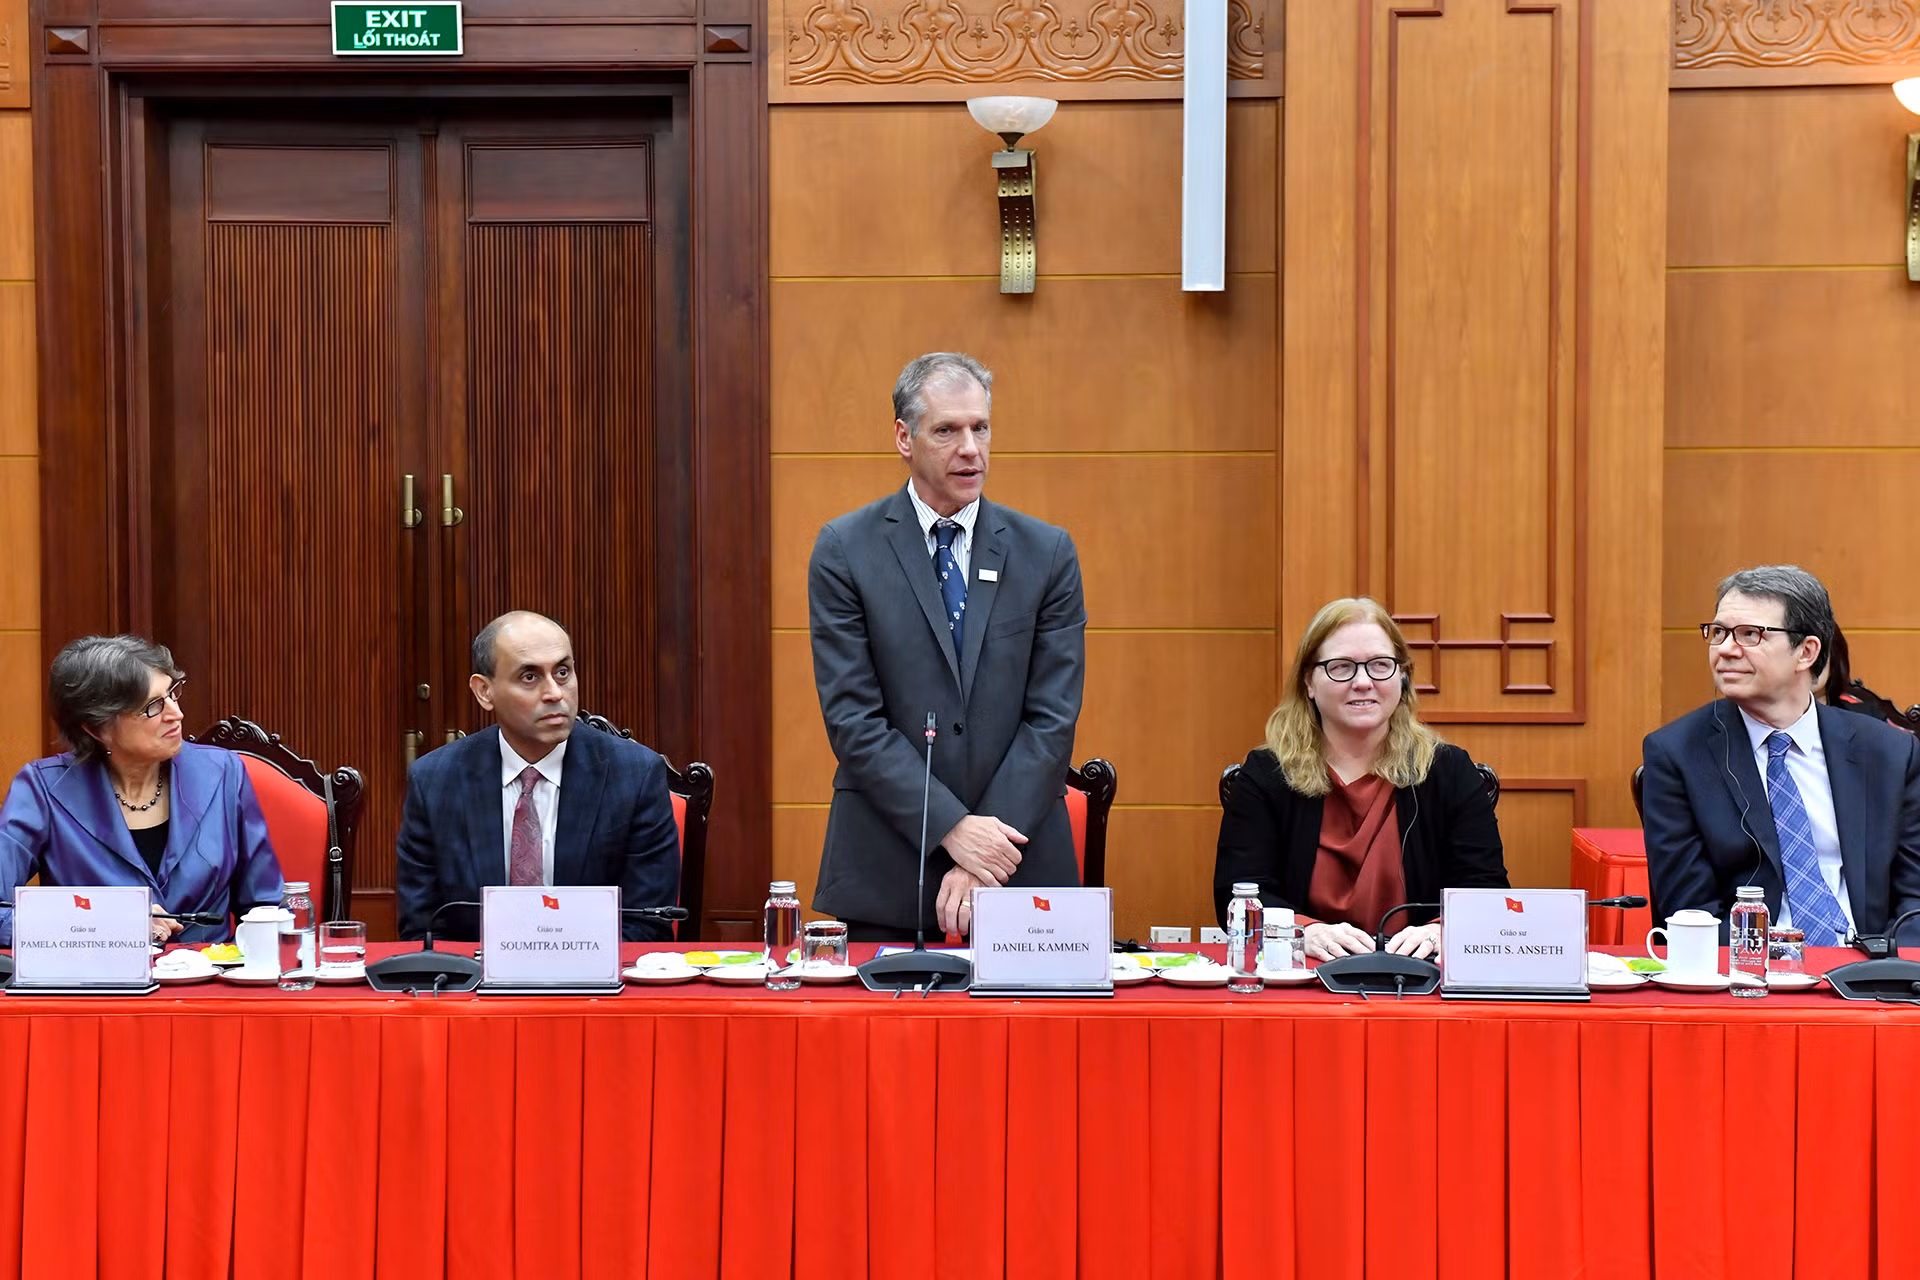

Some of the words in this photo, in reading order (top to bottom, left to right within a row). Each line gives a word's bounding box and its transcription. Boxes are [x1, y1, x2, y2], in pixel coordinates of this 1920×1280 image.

[366, 10, 427, 28] EXIT
[354, 28, 381, 47] LỐI
[383, 30, 441, 46] THOÁT
[1499, 929, 1517, 937] Giáo
[20, 941, 58, 949] PAMELA
[59, 941, 107, 949] CHRISTINE
[108, 941, 146, 949] RONALD
[500, 941, 559, 951] SOUMITRA
[562, 941, 600, 951] DUTTA
[992, 943, 1035, 952] DANIEL
[1038, 943, 1090, 952] KAMMEN
[1464, 945, 1501, 954] KRISTI
[1504, 945, 1514, 954] S.
[1517, 945, 1563, 955] ANSETH
